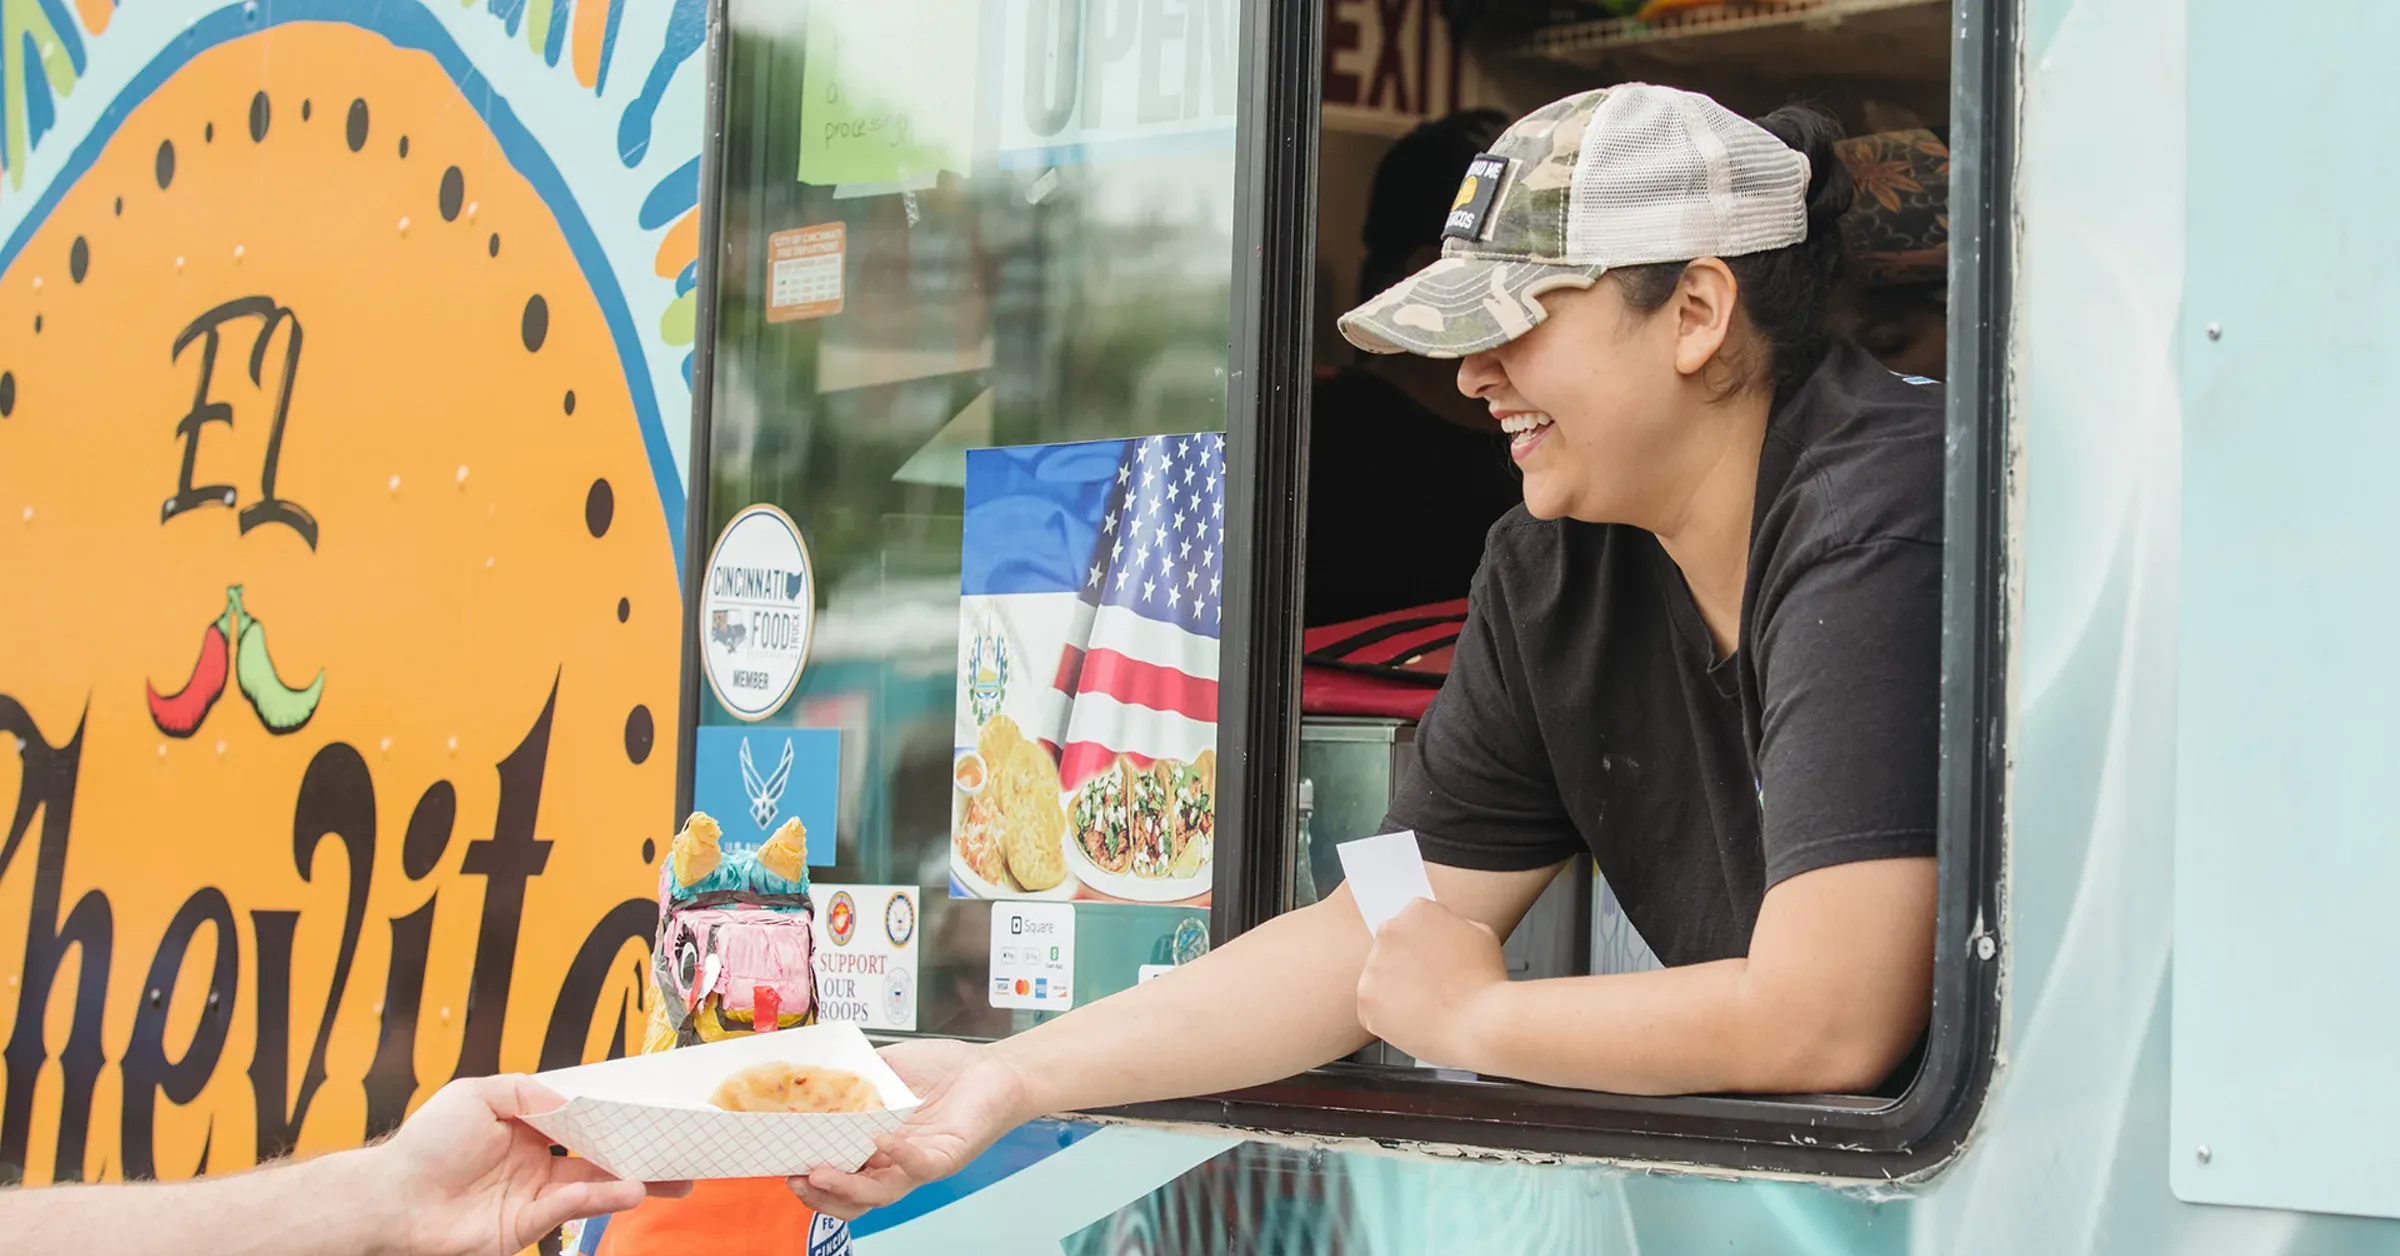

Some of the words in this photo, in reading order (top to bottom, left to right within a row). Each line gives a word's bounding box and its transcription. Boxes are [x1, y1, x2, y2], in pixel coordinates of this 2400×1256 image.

[1022, 0, 1236, 138] OPEN
[1484, 161, 1503, 179] ME
[714, 566, 785, 600] CINCINNATI
[752, 611, 790, 649] FOOD
[790, 613, 800, 650] TRUCK
[733, 669, 769, 690] MEMBER
[0, 665, 660, 1188] hevito
[1024, 919, 1054, 936] Square
[820, 953, 888, 974] SUPPORT
[824, 978, 856, 998] OUR
[819, 1001, 869, 1021] ROOPS
[822, 1217, 835, 1230] FC
